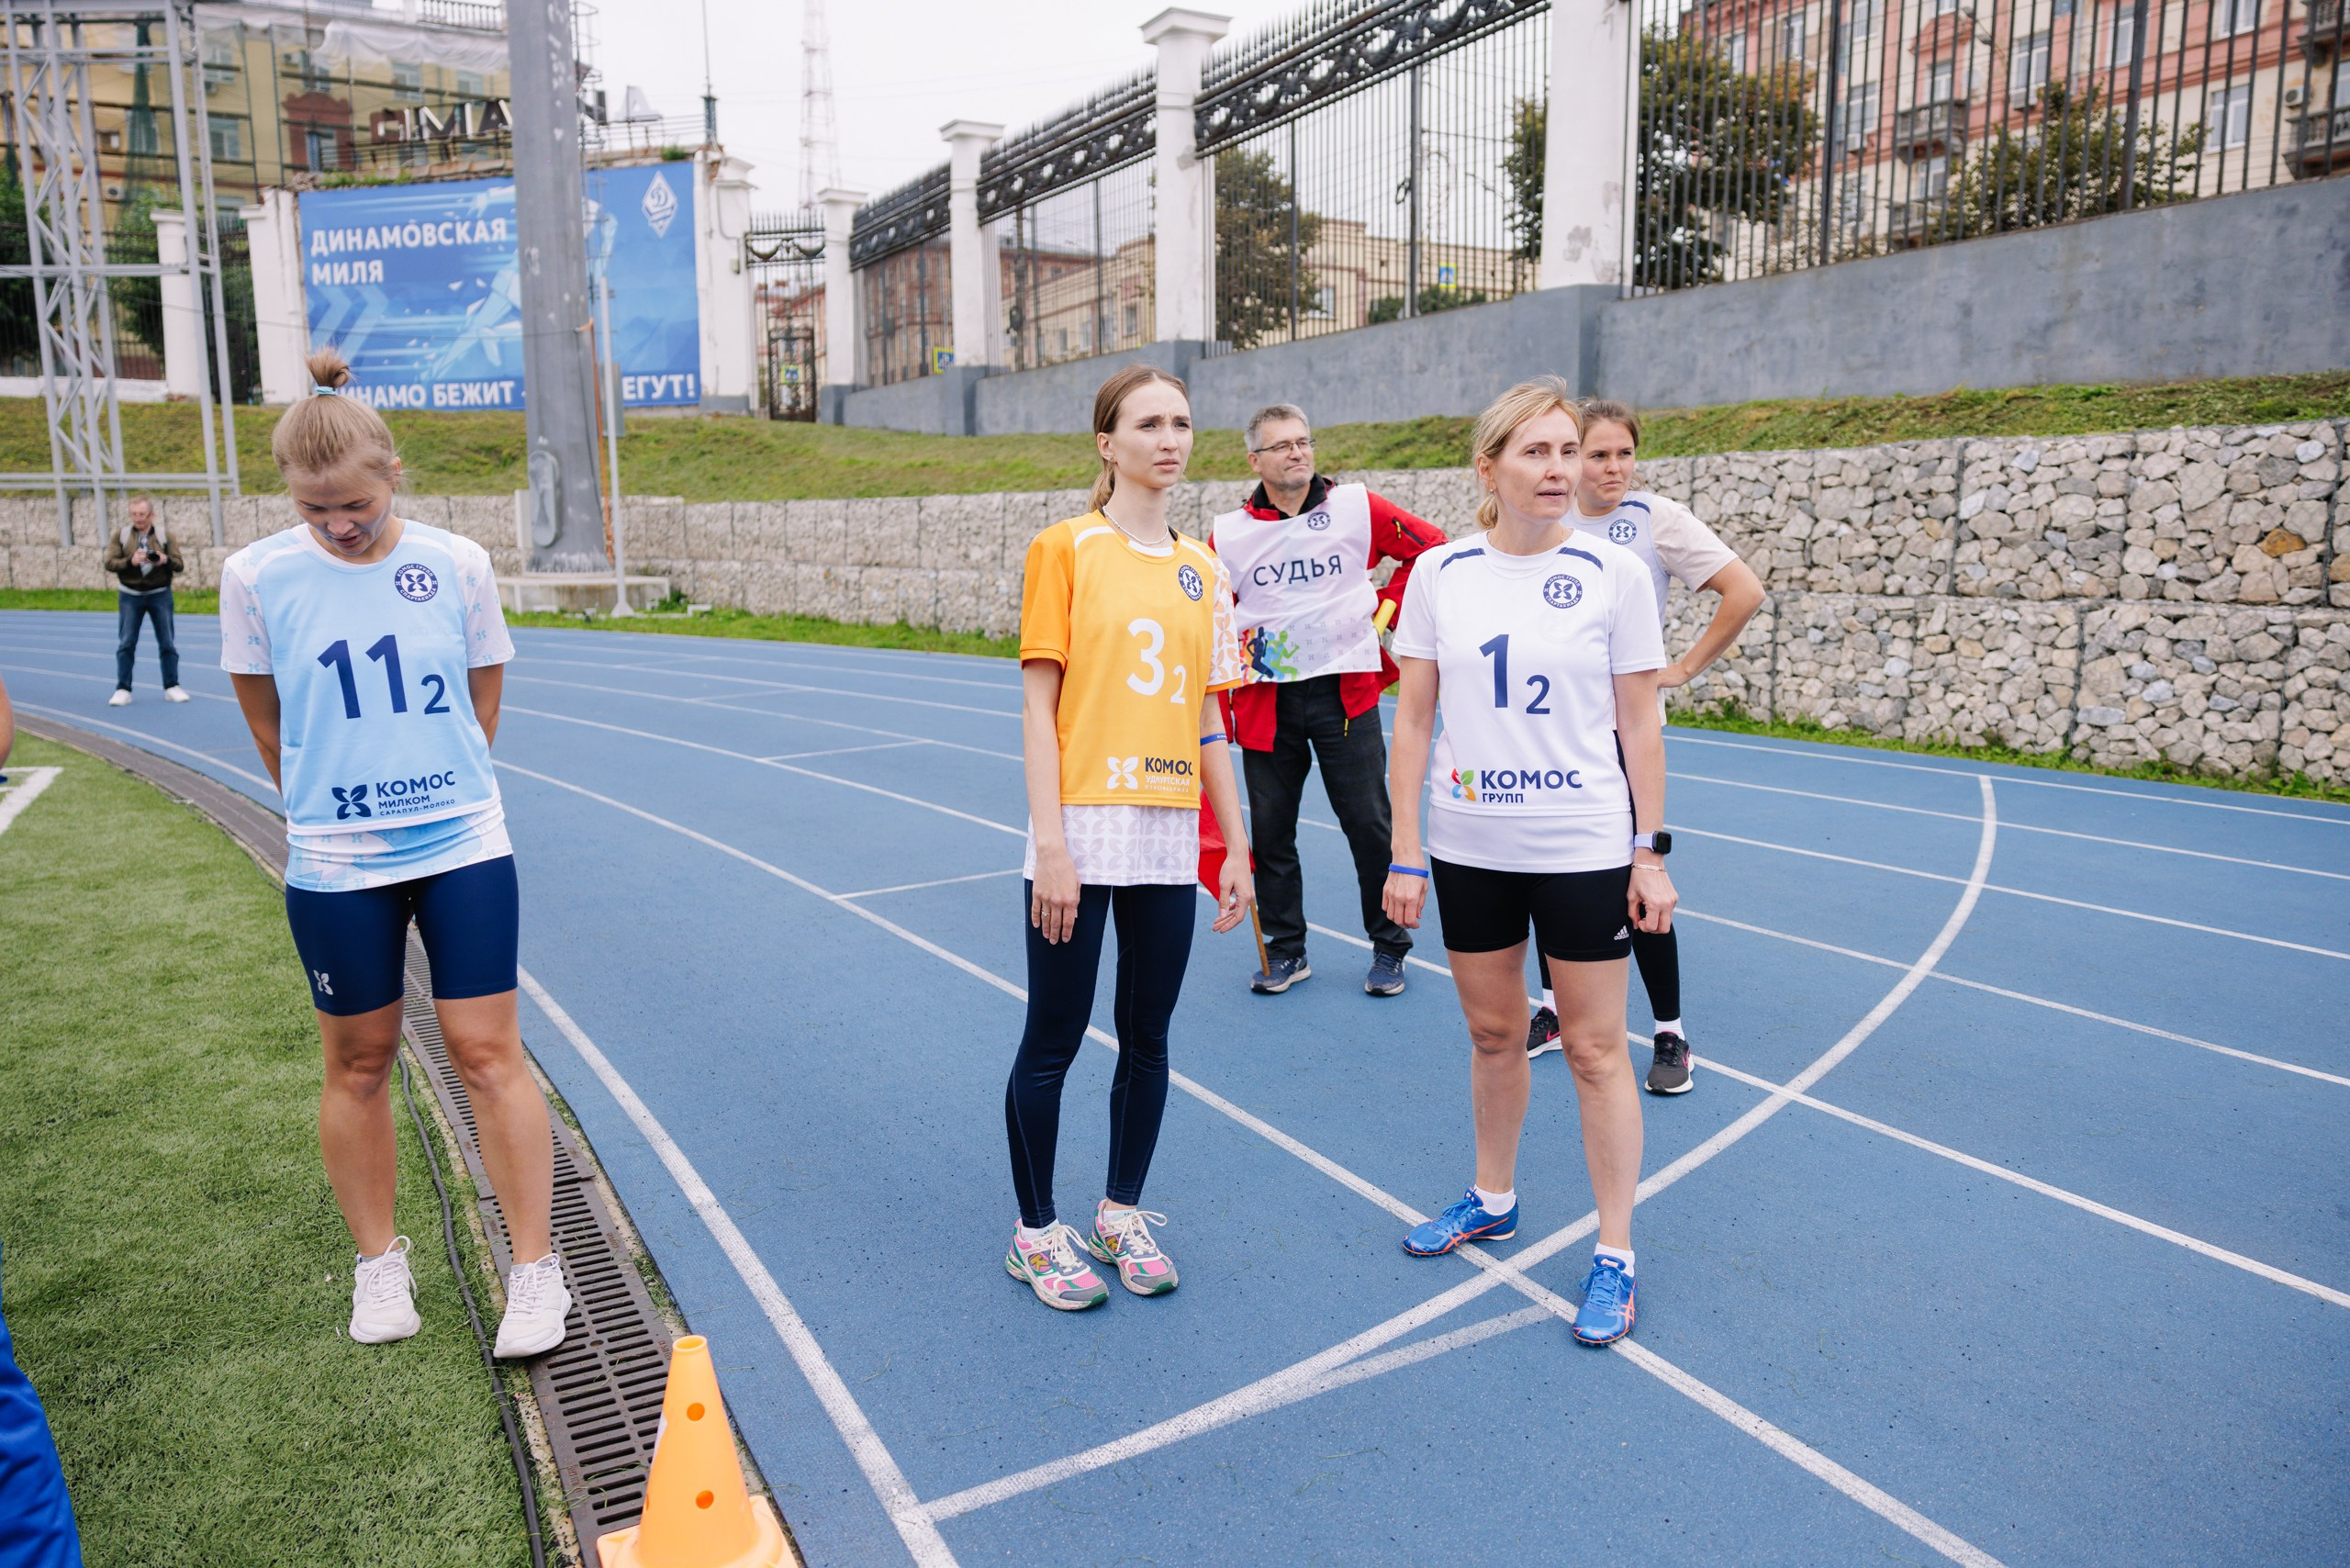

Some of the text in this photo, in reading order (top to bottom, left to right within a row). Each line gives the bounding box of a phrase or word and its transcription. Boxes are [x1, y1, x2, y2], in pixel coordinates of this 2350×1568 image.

[310, 218, 508, 257] ДИНАМОВСКАЯ
[312, 260, 384, 286] МИЛЯ
[337, 373, 695, 409] ИНАМО БЕЖИТ ЕГУТ!
[1253, 554, 1342, 586] СУДЬЯ
[1125, 618, 1186, 705] 3 2
[1479, 634, 1550, 714] 1 2
[317, 634, 451, 719] 11 2
[1145, 757, 1193, 776] КОМОС
[1481, 769, 1583, 790] КОМОС
[375, 771, 455, 798] КОМОС
[1482, 792, 1524, 803] ГРУПП
[378, 795, 431, 809] МИЛКОМ
[380, 800, 455, 816] САРАПУЛ-МОЛОКО
